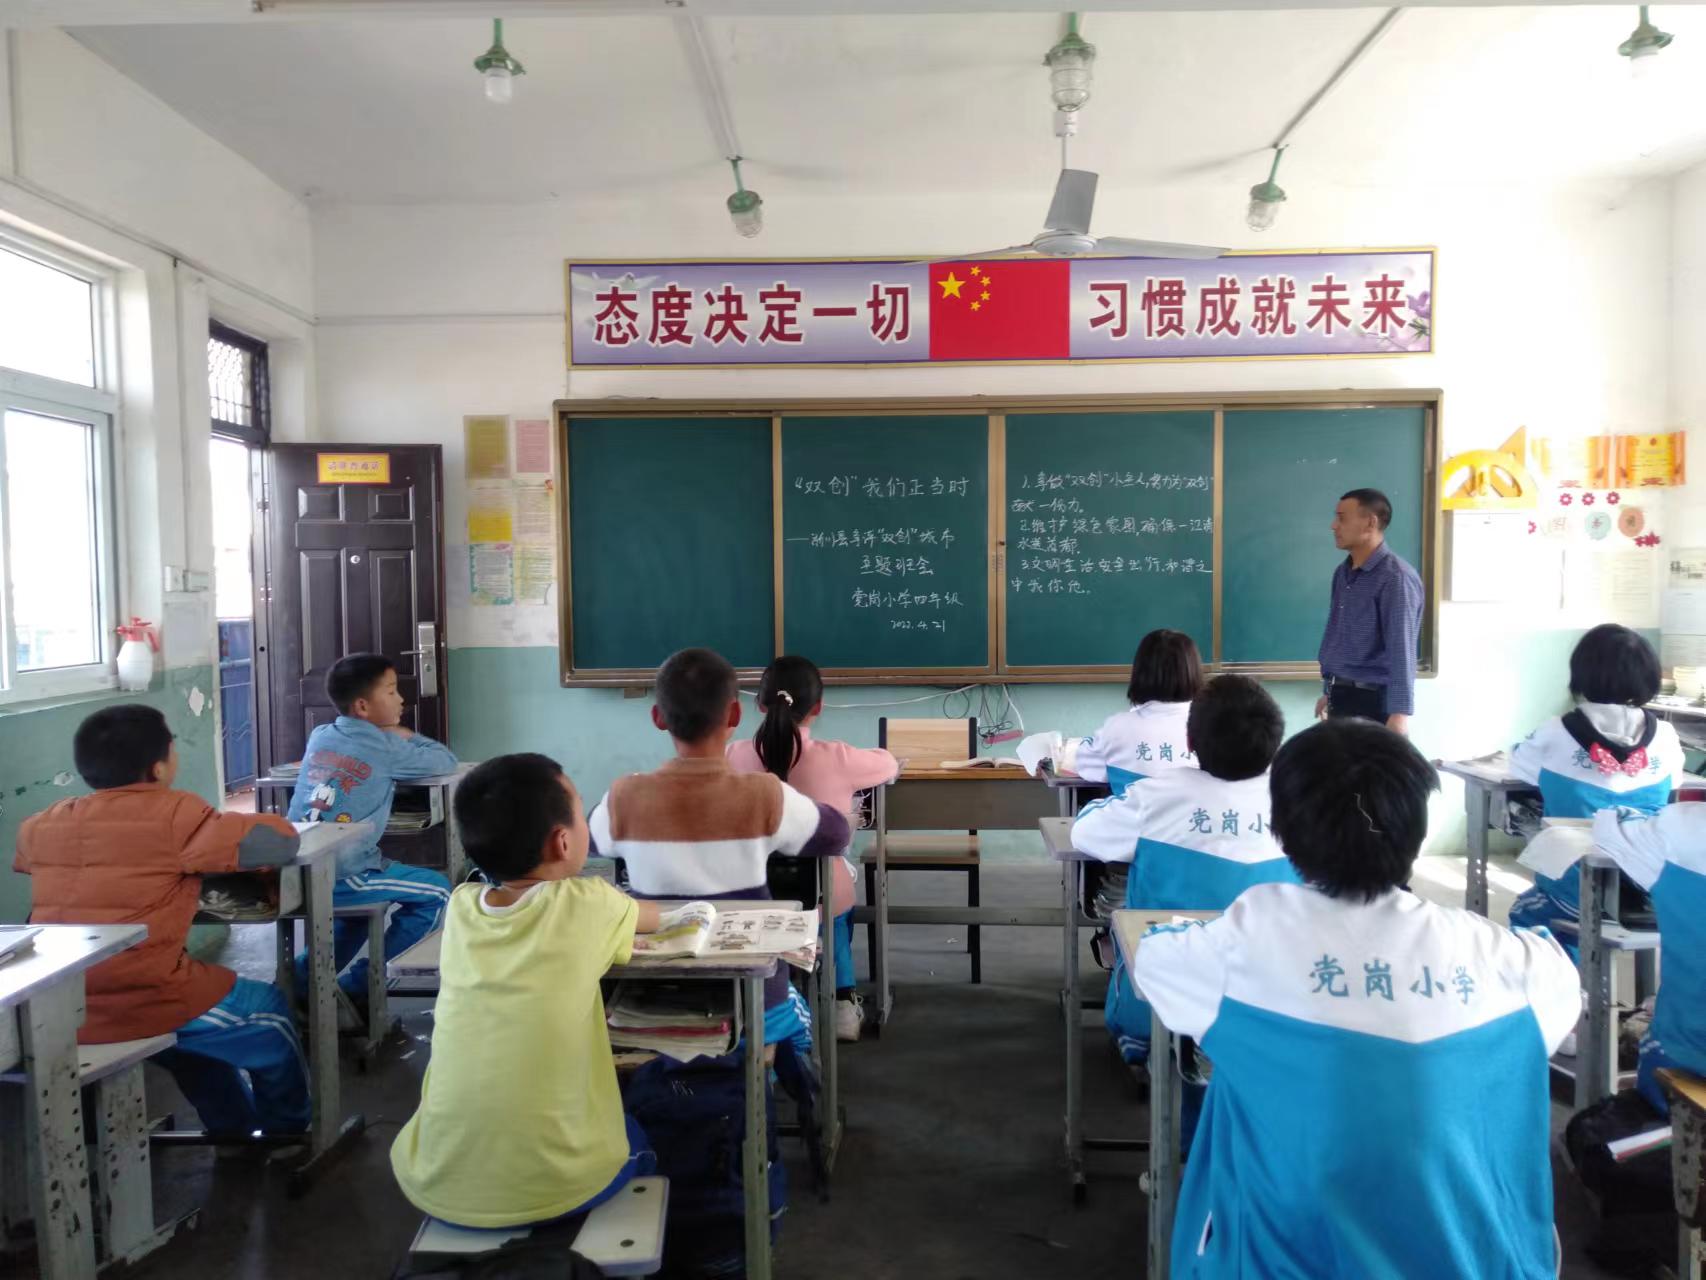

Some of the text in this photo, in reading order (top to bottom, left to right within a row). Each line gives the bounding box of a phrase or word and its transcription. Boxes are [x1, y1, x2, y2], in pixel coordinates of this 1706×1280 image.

[594, 274, 1409, 346] 态度决定一切 习惯成就未来
[861, 555, 933, 576] 主题班会
[852, 587, 964, 608] 党岗小学四年级
[1136, 741, 1191, 762] 党岗小
[1189, 808, 1270, 836] 党岗小
[1310, 954, 1475, 1004] 党岗小学
